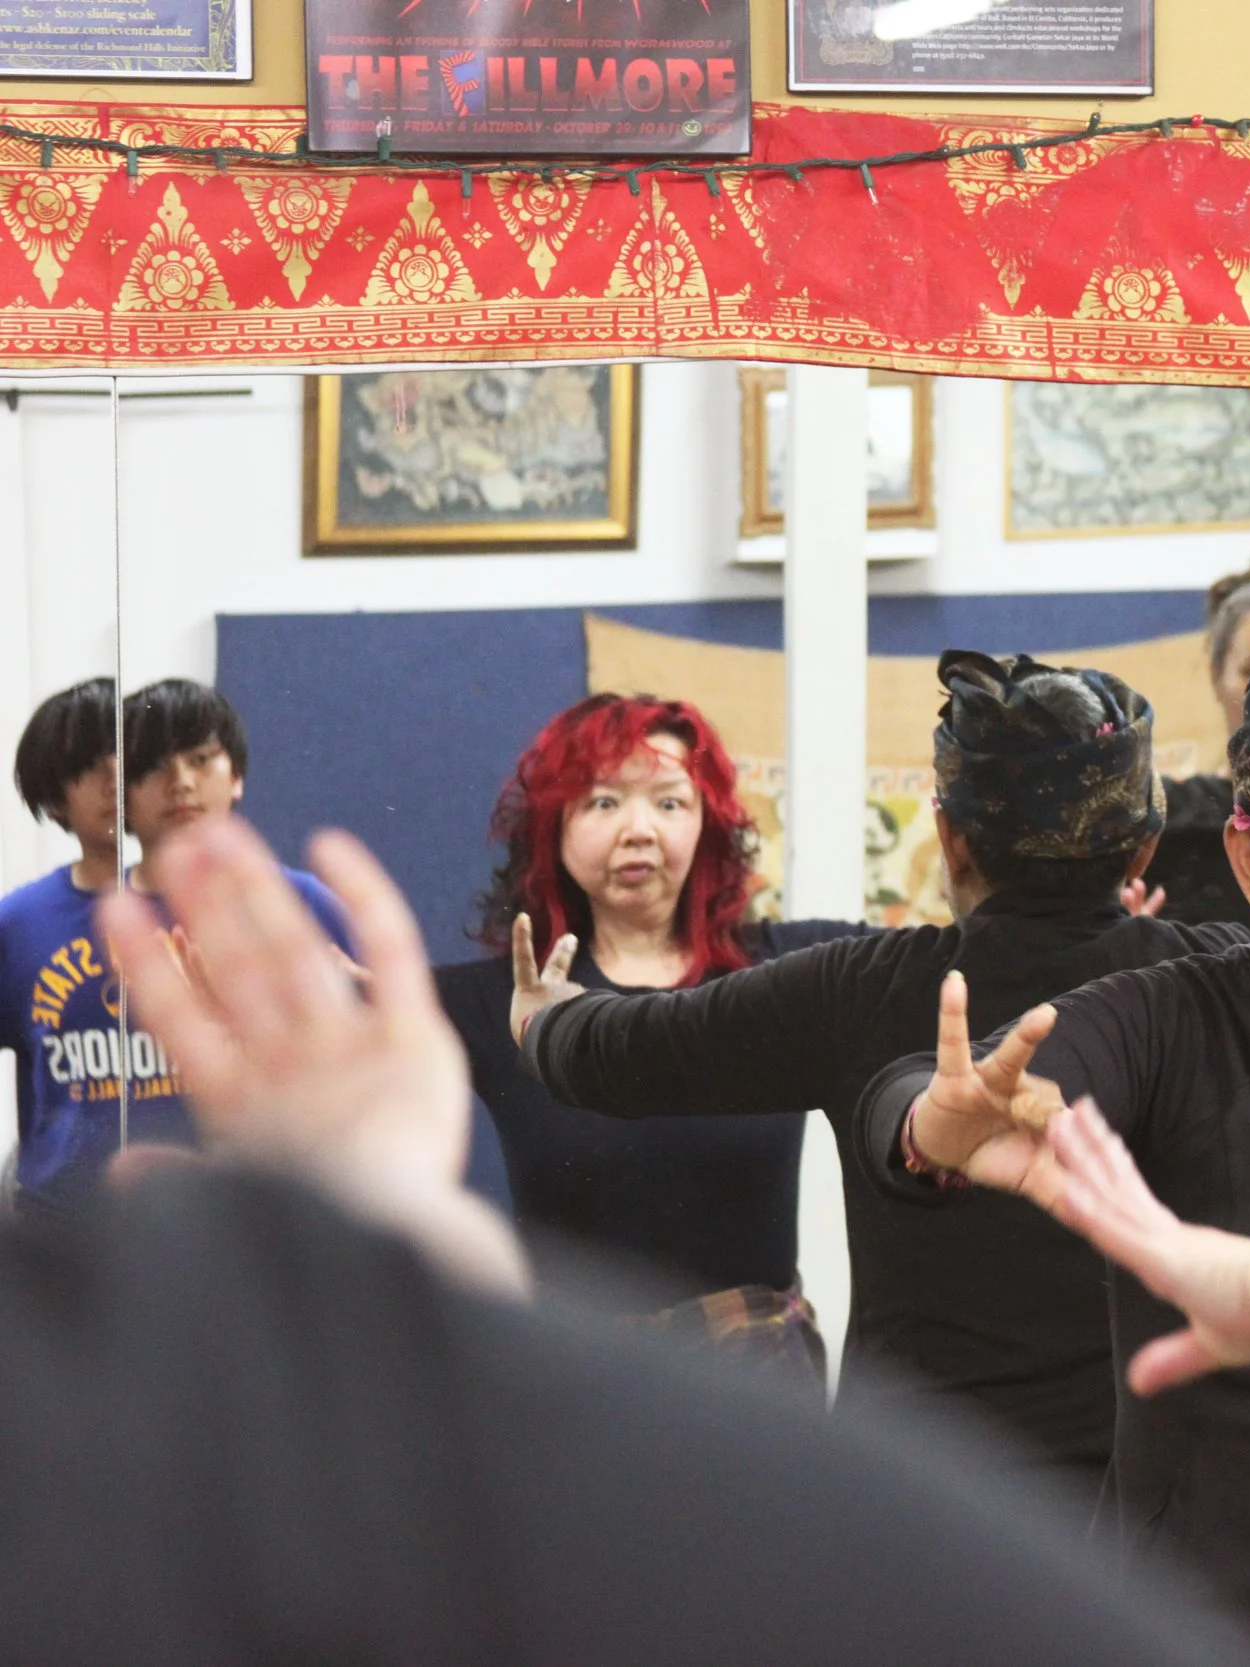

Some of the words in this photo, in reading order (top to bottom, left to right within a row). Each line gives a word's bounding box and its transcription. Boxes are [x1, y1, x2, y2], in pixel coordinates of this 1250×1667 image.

[128, 8, 157, 20] scale
[318, 55, 429, 112] THE
[439, 50, 737, 117] FILLMORE
[403, 120, 451, 132] FRIDAY
[473, 121, 543, 133] SATURDAY
[552, 122, 611, 134] OCTOBER
